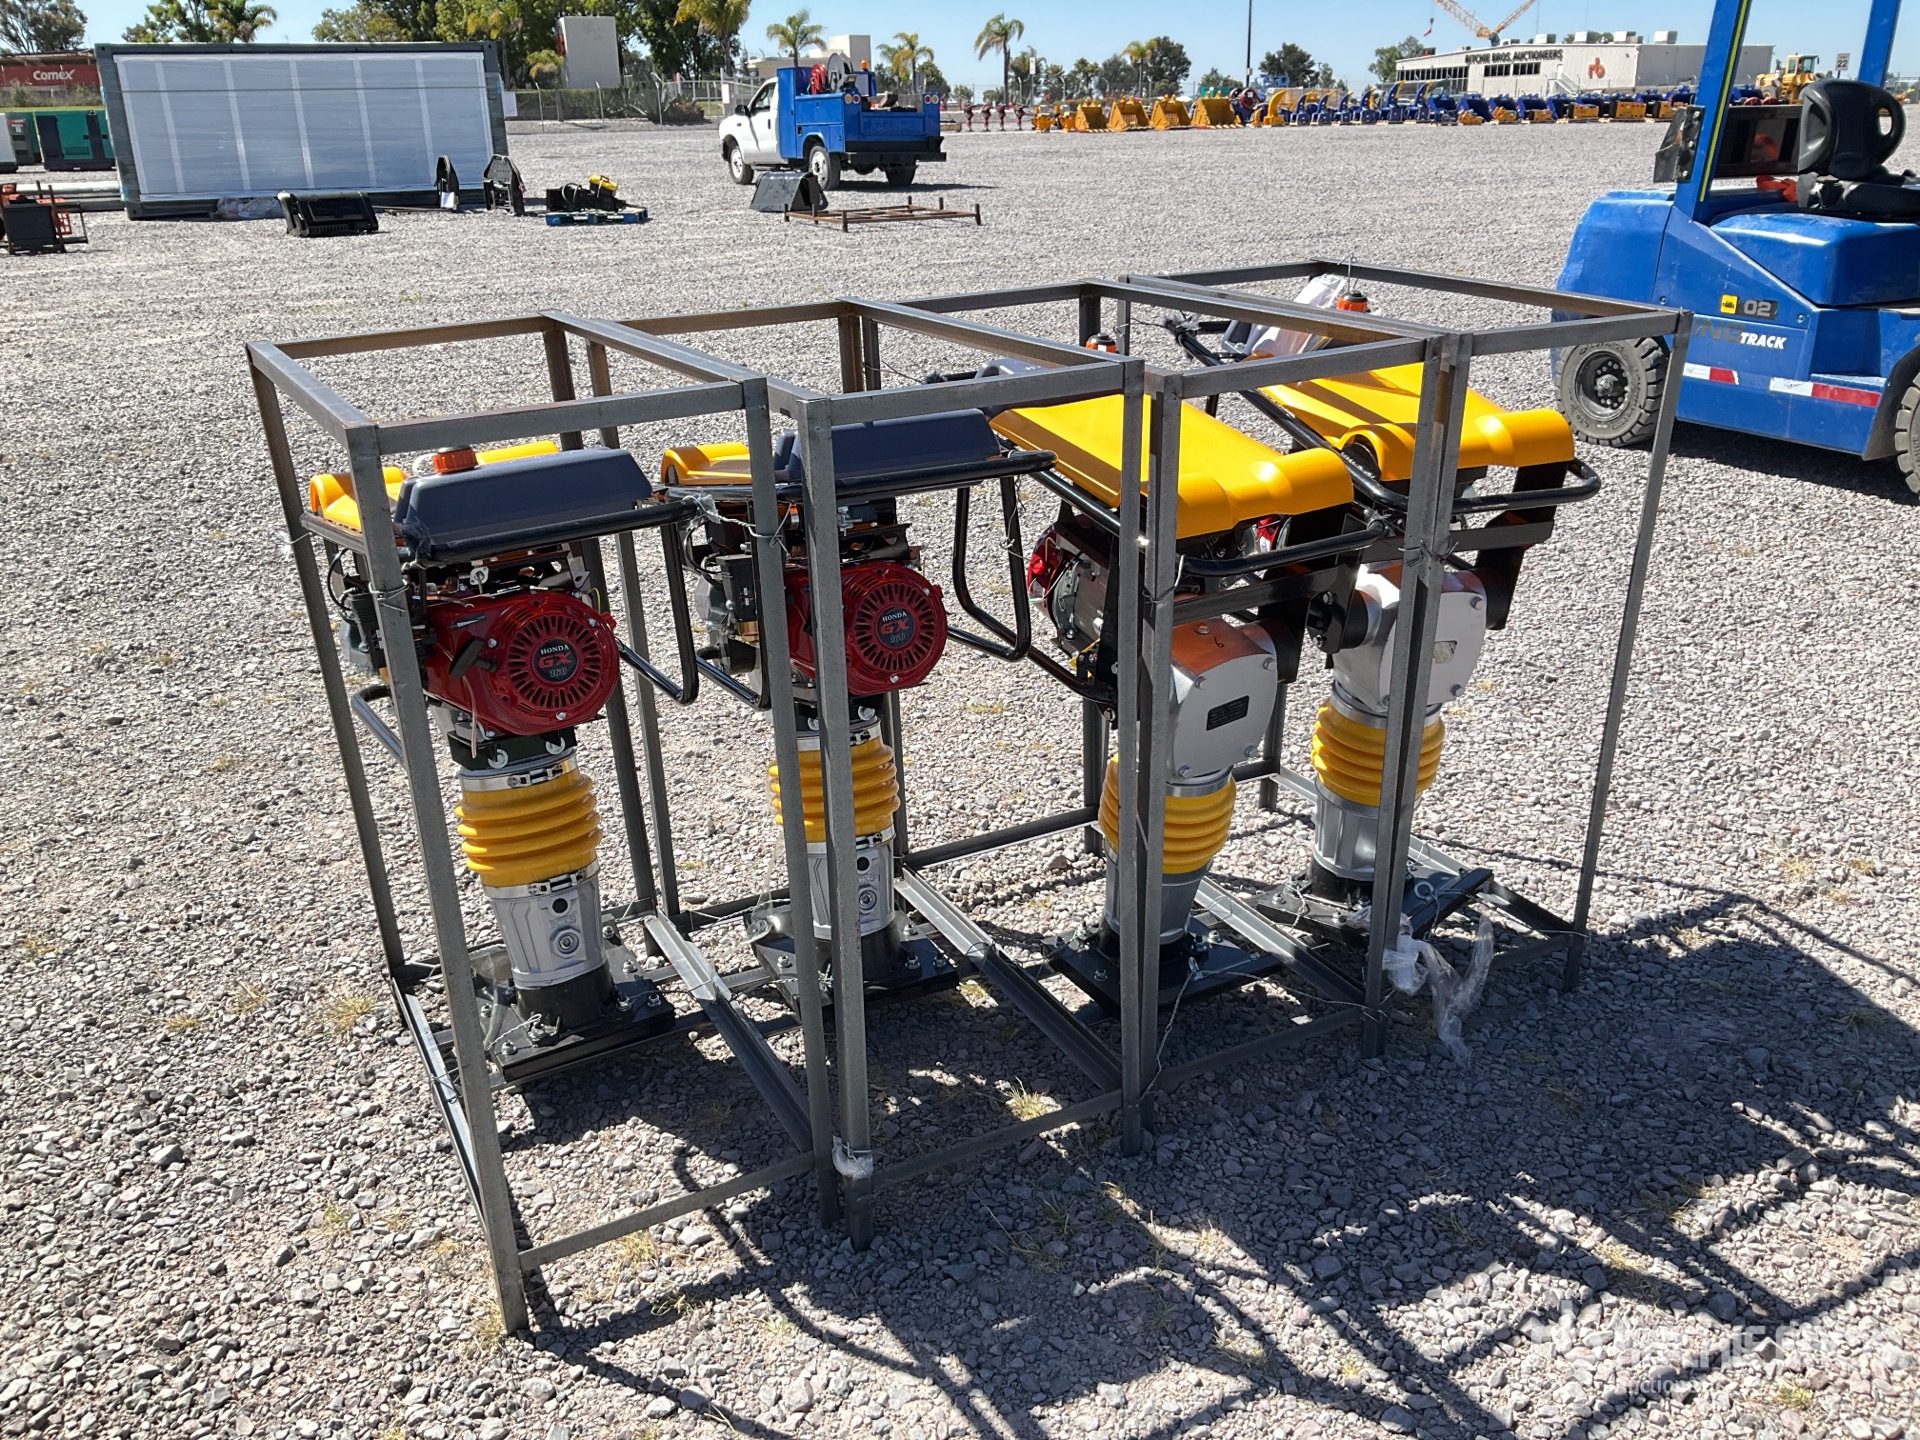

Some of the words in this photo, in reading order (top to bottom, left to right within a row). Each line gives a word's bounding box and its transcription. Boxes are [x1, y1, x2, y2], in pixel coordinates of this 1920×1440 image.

[1465, 52, 1491, 64] RITCHIE
[1512, 49, 1564, 61] AUCTIONEERS
[1837, 60, 1848, 68] 22
[33, 69, 76, 81] Comex
[1743, 299, 1772, 317] 02
[1740, 332, 1787, 349] TRACK
[882, 611, 907, 622] HONDA
[880, 617, 910, 635] GX
[540, 644, 570, 655] HONDA
[538, 651, 573, 669] GX
[550, 667, 568, 678] 160
